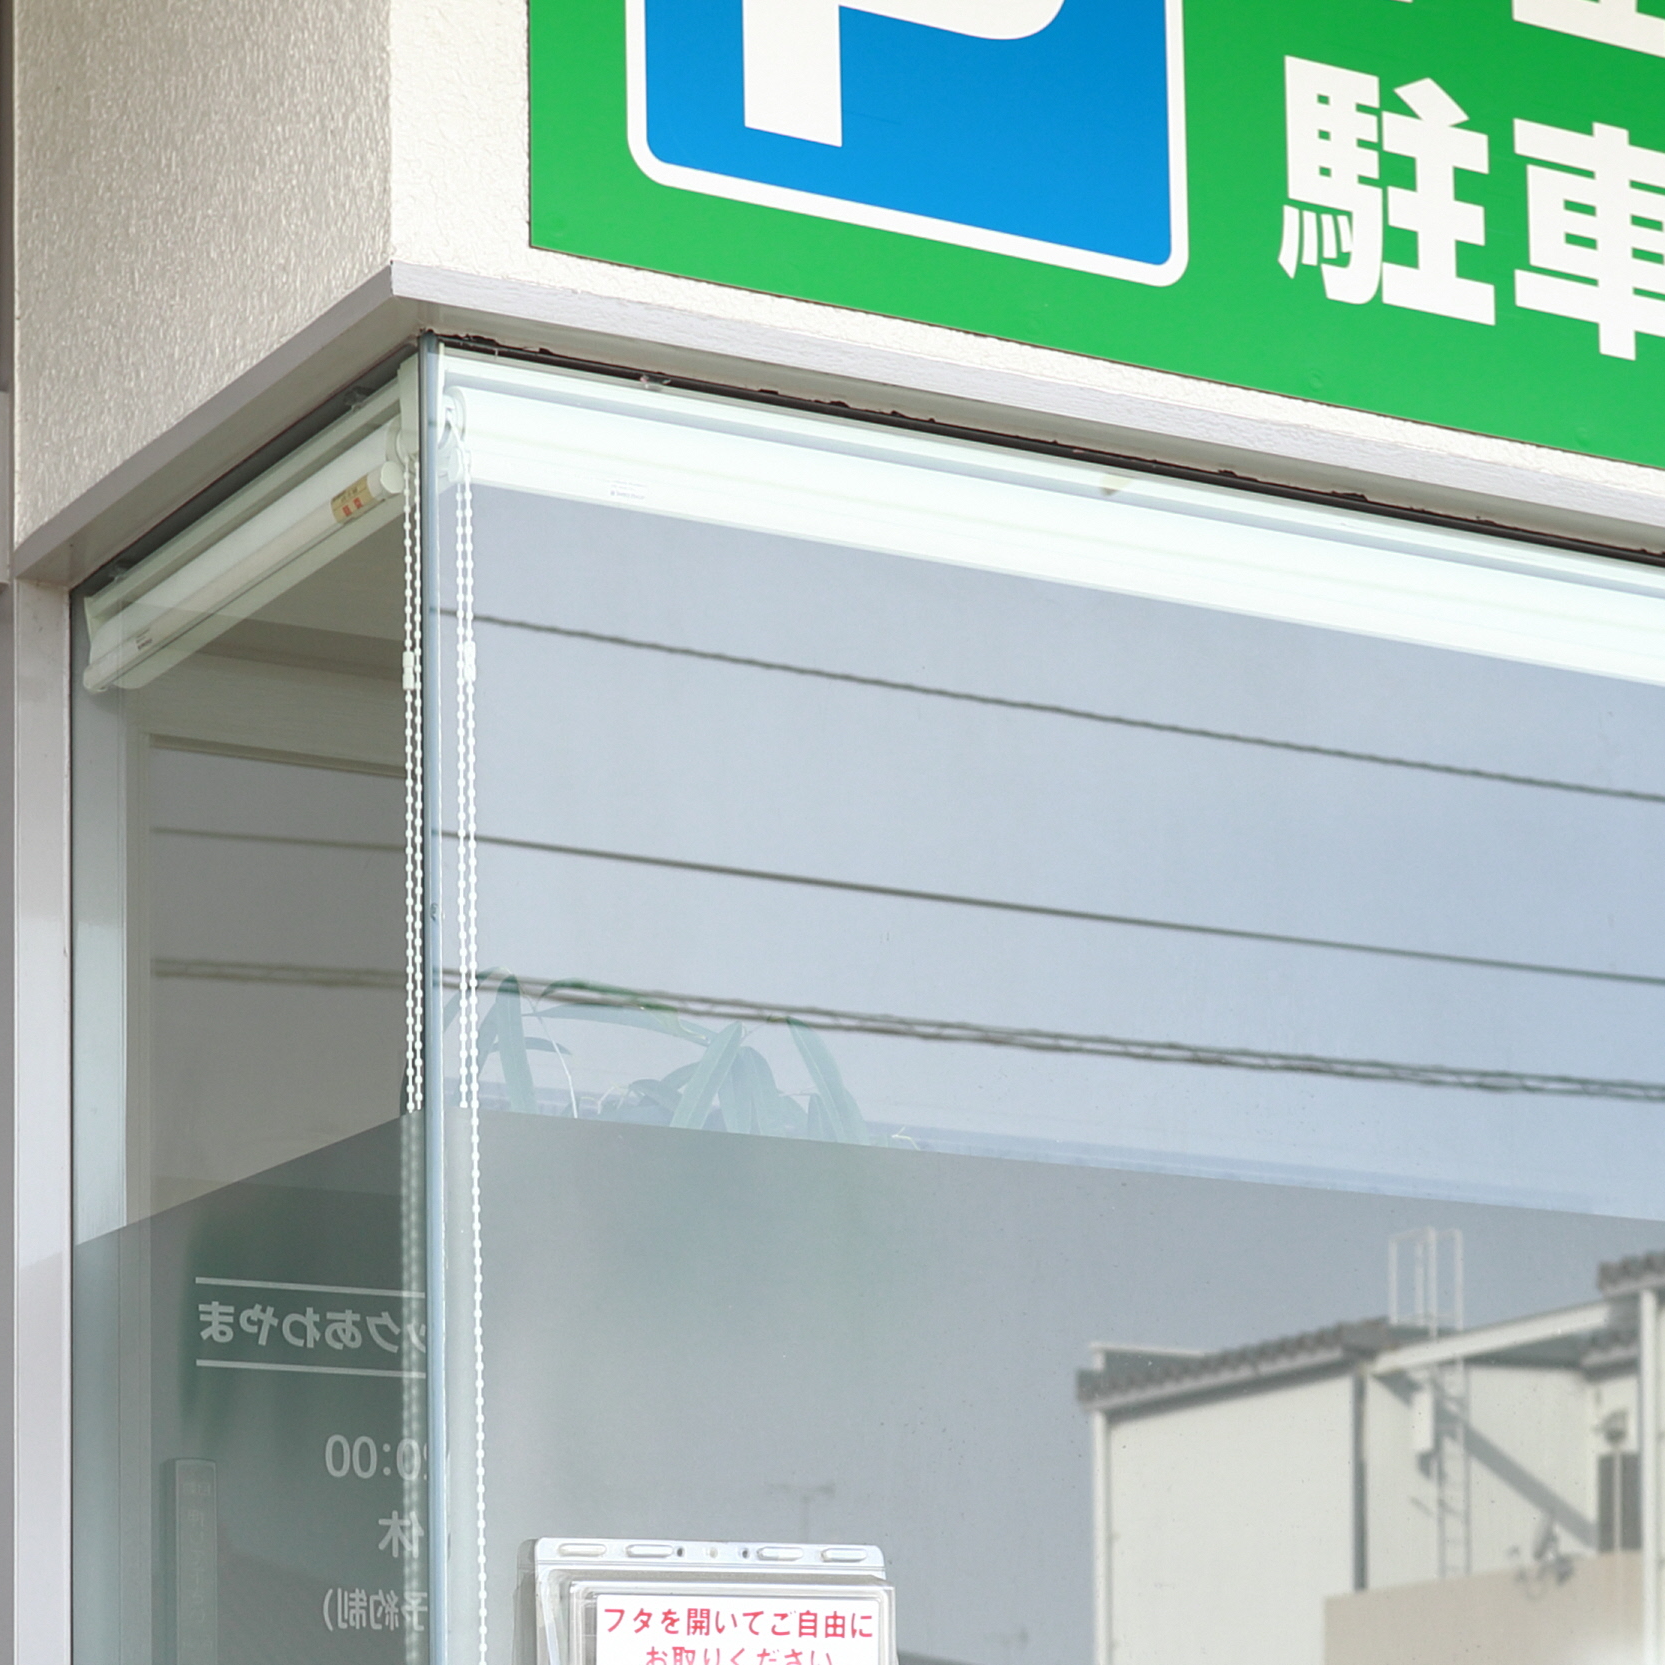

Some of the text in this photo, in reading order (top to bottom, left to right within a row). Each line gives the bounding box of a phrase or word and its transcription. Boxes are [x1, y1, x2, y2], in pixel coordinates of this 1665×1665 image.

[604, 1607, 873, 1638] フタを開いてご自由に
